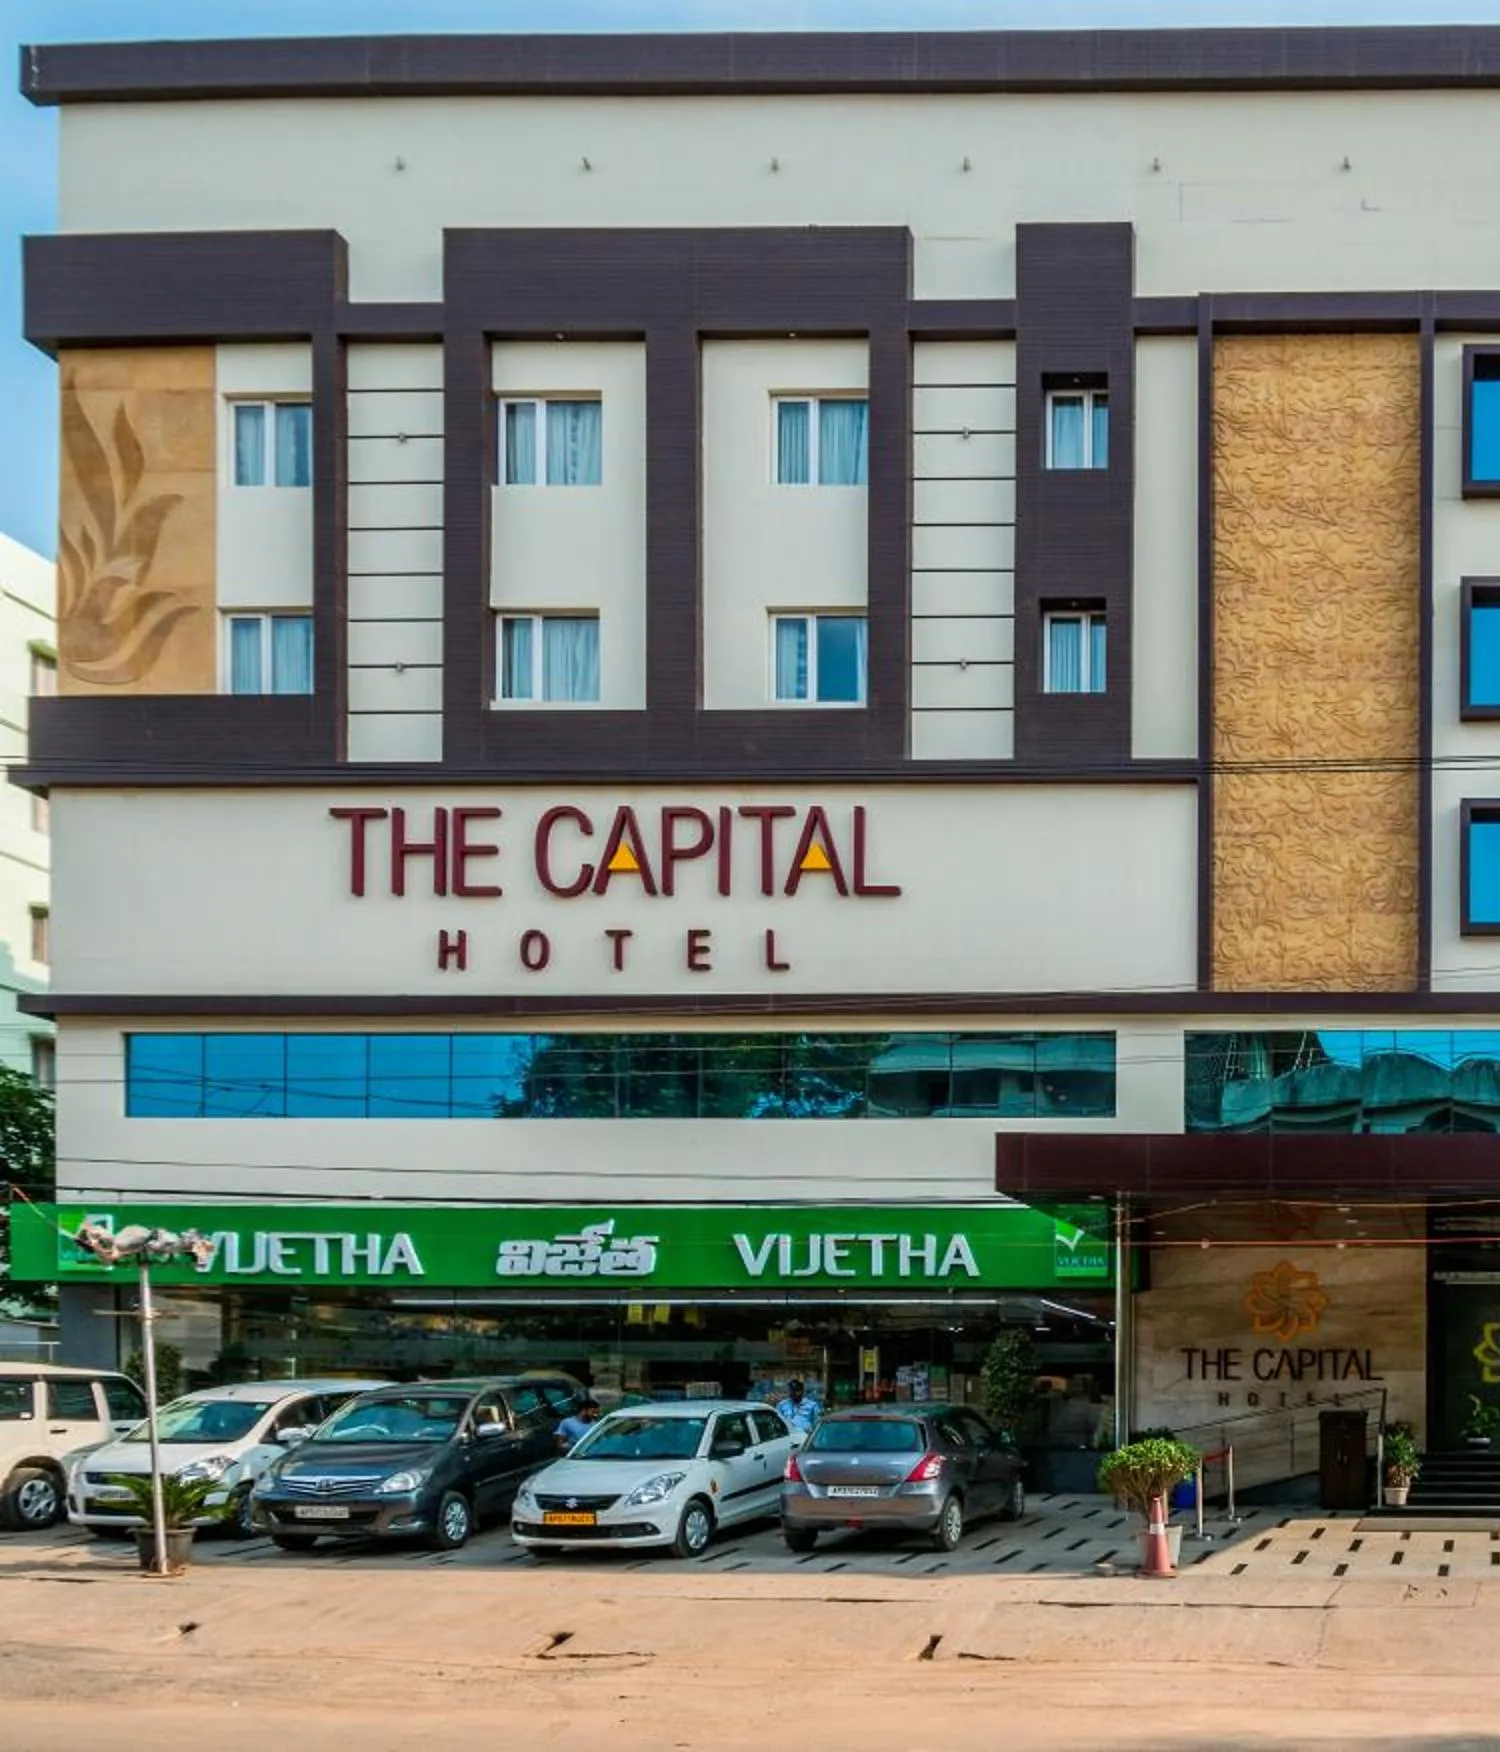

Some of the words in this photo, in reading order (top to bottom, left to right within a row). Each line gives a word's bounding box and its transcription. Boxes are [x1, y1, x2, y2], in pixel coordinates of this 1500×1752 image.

[329, 806, 503, 897] THE
[534, 806, 902, 897] CAPITAL
[438, 929, 791, 971] HOTEL
[495, 1218, 660, 1276] విజేత
[733, 1233, 981, 1277] VIJETHA
[1180, 1348, 1243, 1381] THE
[1252, 1347, 1385, 1382] CAPITAL
